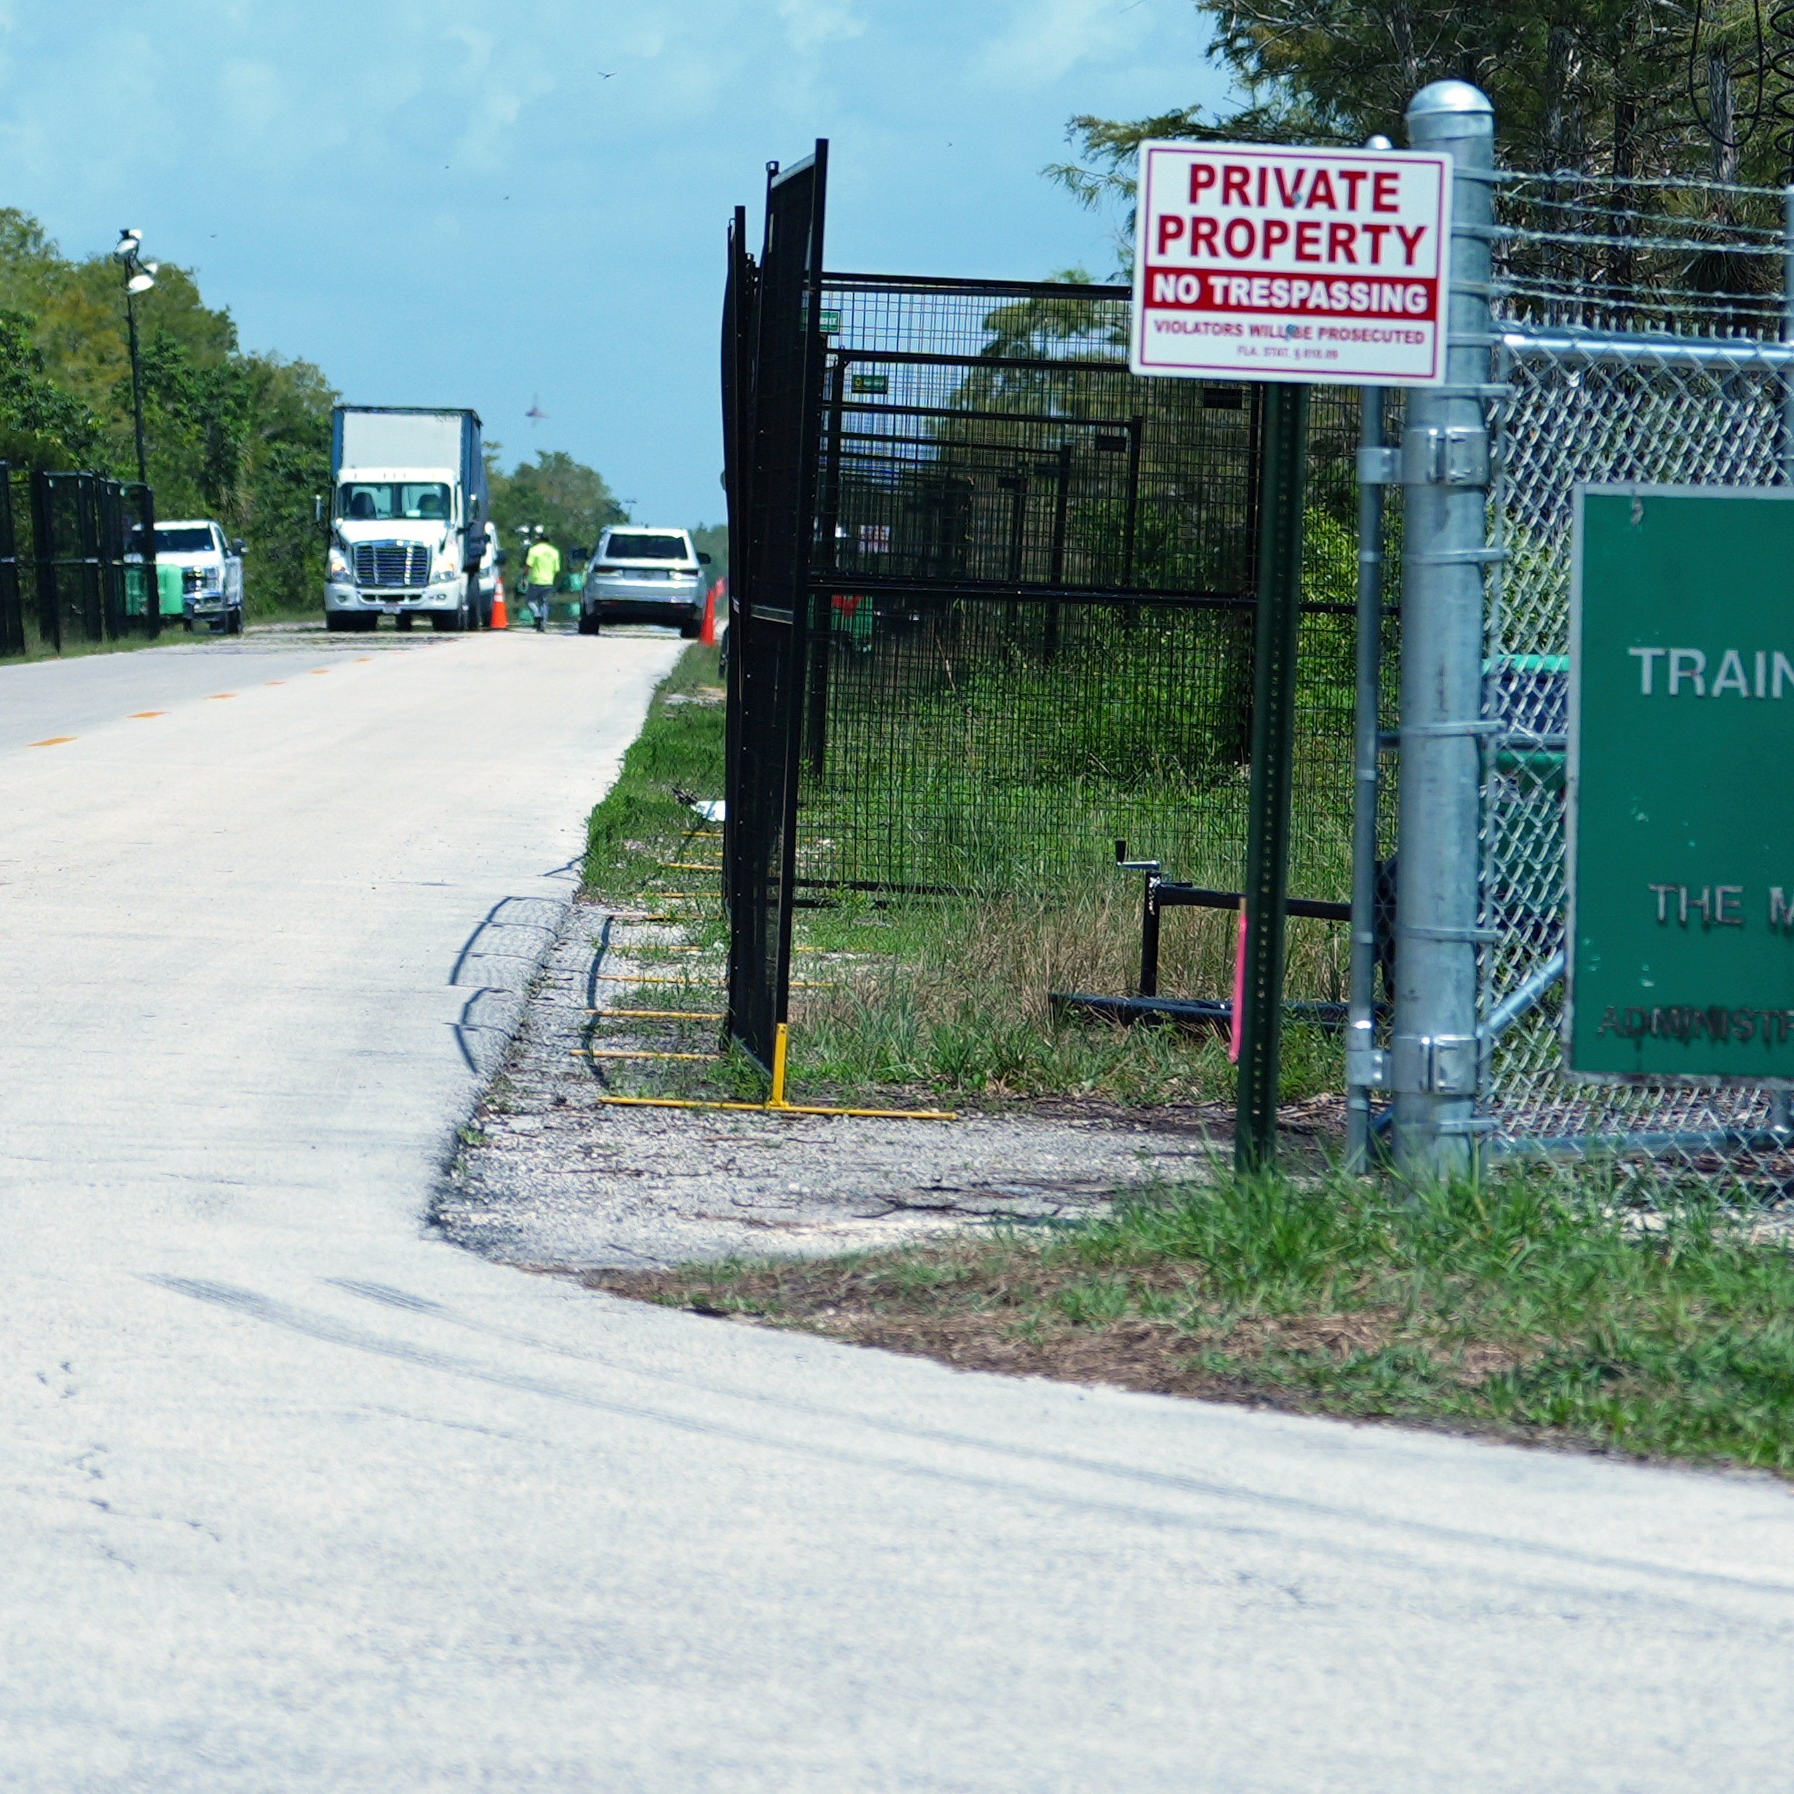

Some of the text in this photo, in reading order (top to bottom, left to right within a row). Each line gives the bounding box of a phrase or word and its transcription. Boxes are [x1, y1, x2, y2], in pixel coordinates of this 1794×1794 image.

[1188, 163, 1401, 213] PRIVATE
[1157, 215, 1428, 266] PROPERTY
[1152, 273, 1428, 314] NO TRESPASSING
[1154, 320, 1244, 337] VIOLATORS
[1249, 323, 1289, 339] WILL
[1318, 327, 1425, 345] PROSECUTED
[1648, 882, 1745, 928] THE
